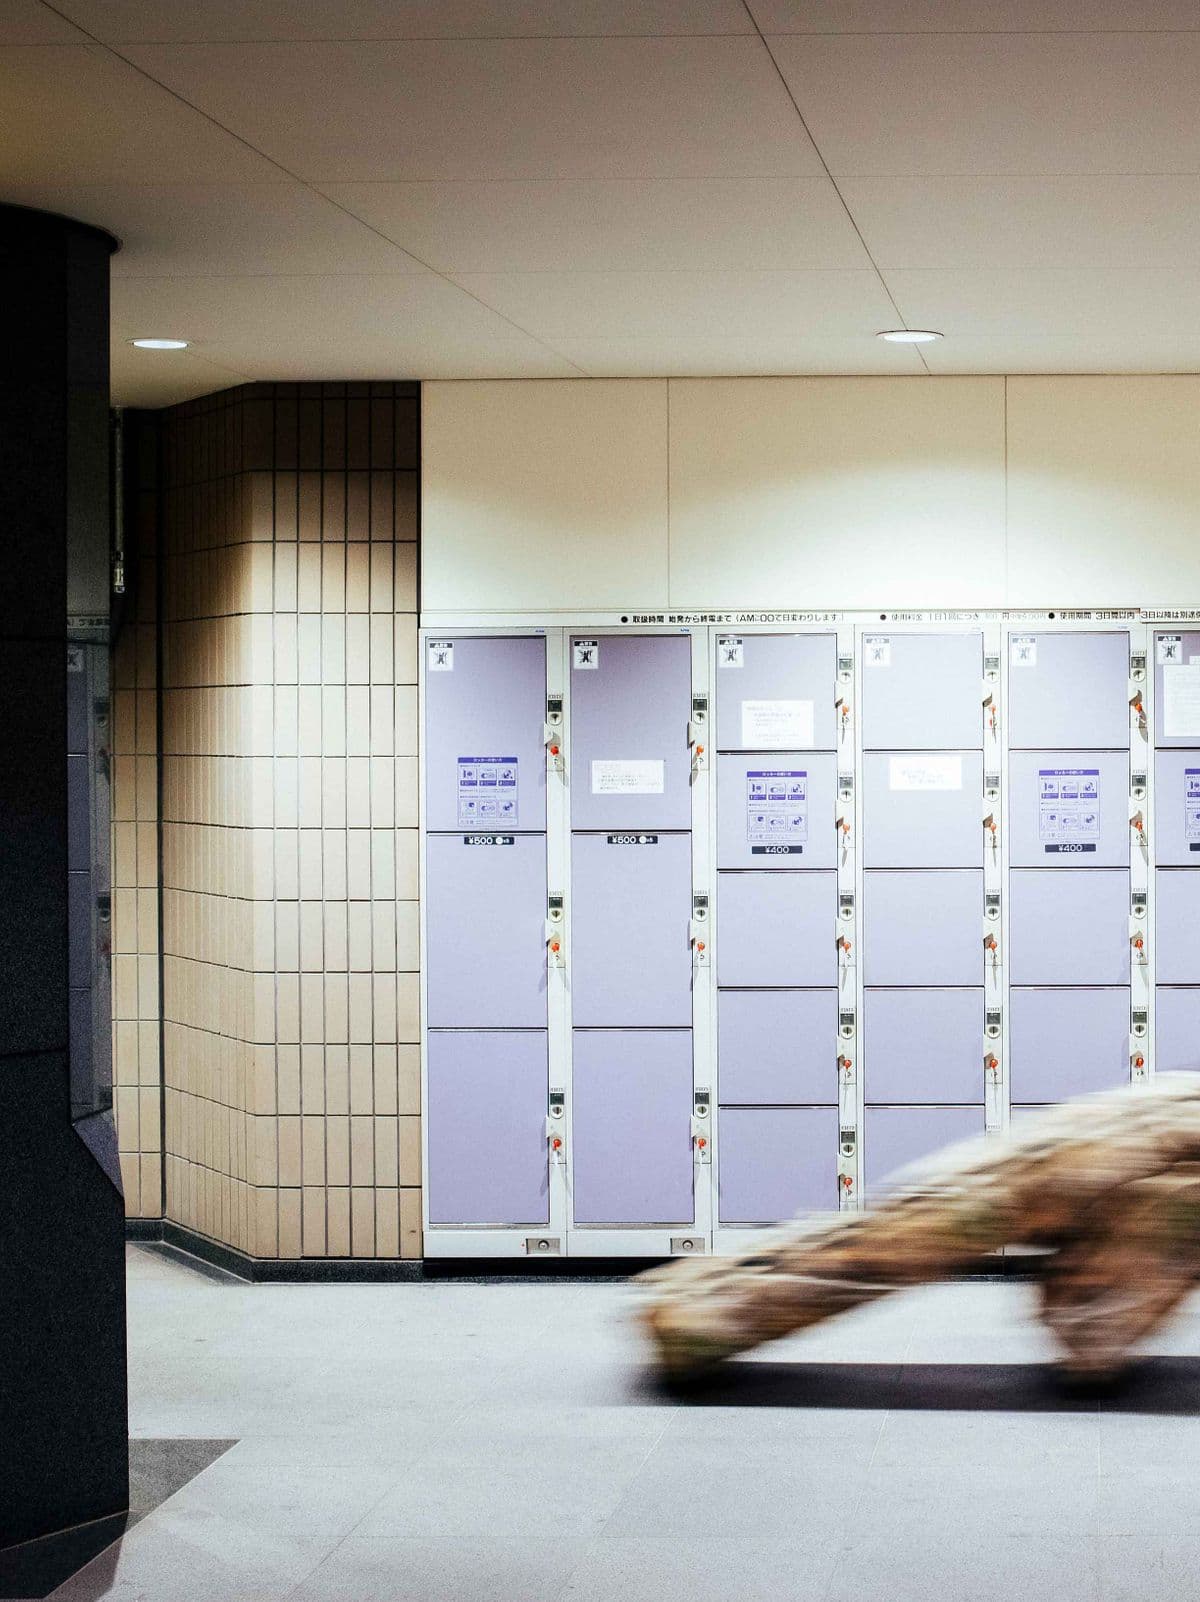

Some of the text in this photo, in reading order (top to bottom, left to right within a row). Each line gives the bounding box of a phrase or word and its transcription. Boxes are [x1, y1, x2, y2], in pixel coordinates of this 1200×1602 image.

[469, 836, 493, 845] ¥500
[612, 836, 637, 844] ¥500
[765, 846, 790, 854] ¥400
[1058, 844, 1083, 852] ¥400
